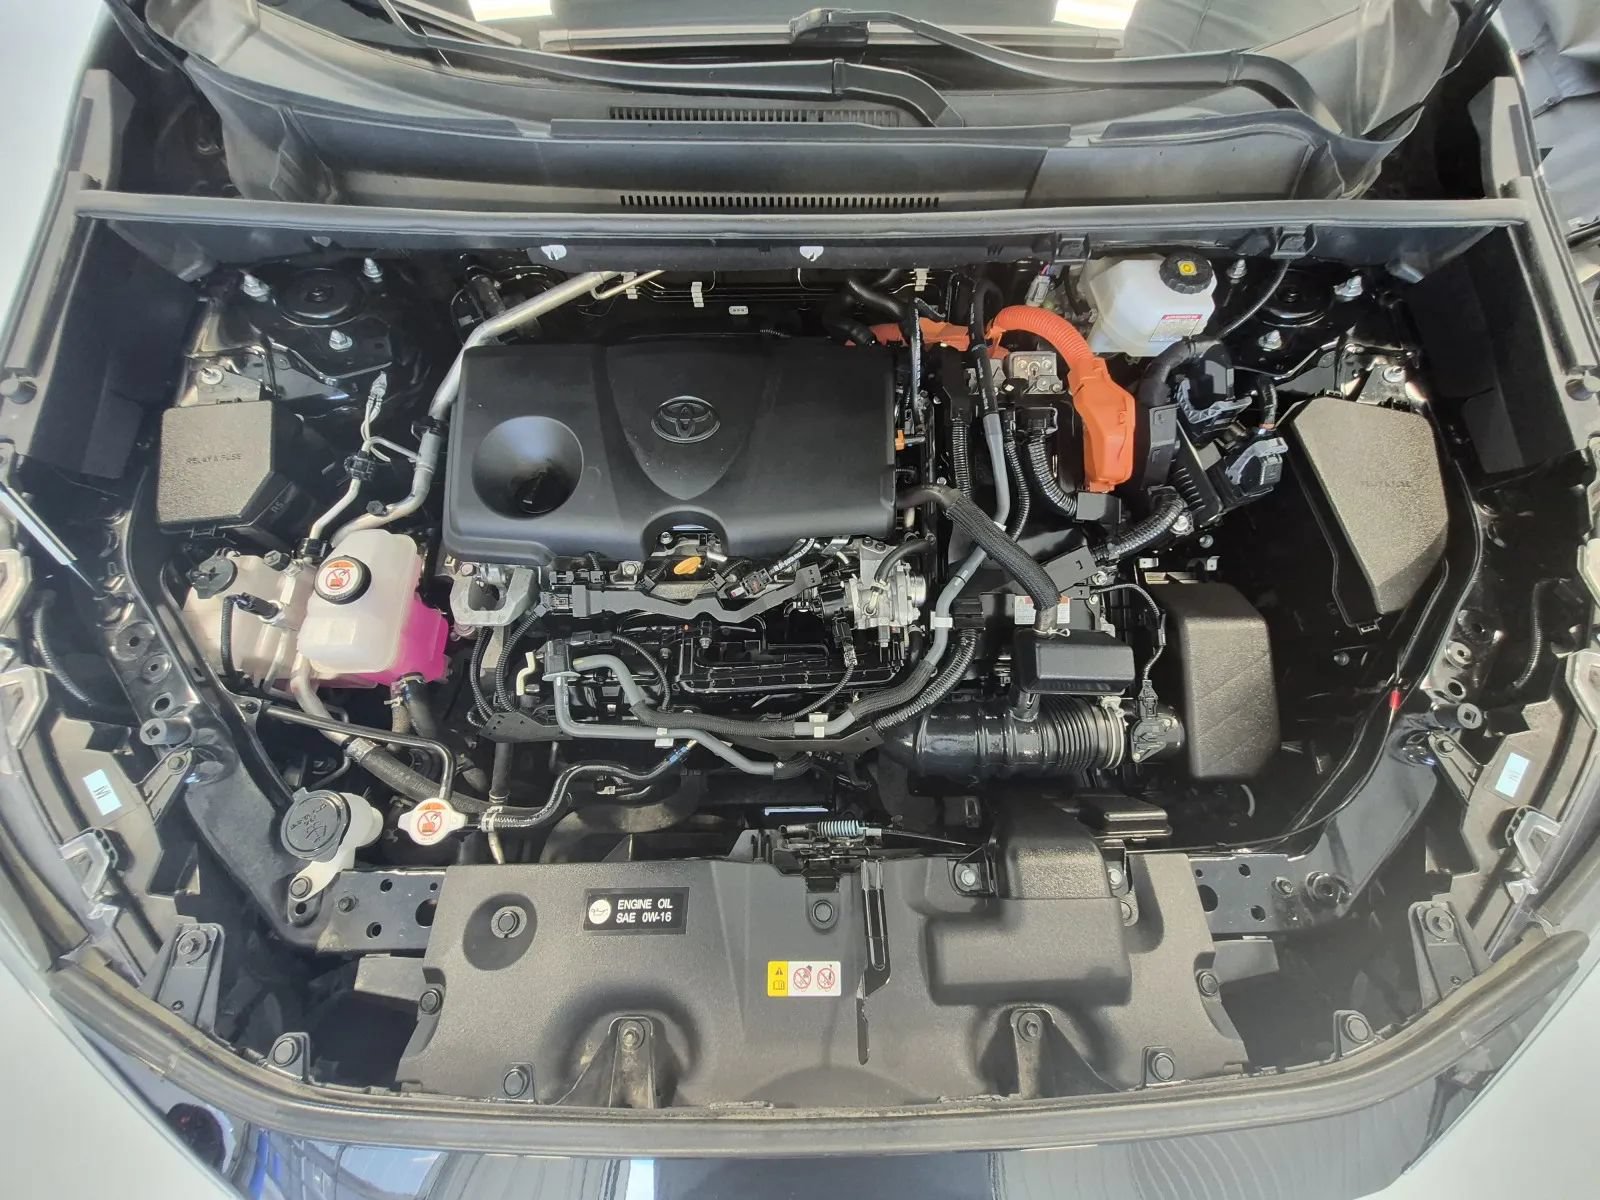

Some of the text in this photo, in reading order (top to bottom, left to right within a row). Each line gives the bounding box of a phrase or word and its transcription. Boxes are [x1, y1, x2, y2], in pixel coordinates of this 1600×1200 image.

[617, 898, 673, 910] ENGINE OIL
[616, 911, 672, 923] SAE 0W-16
